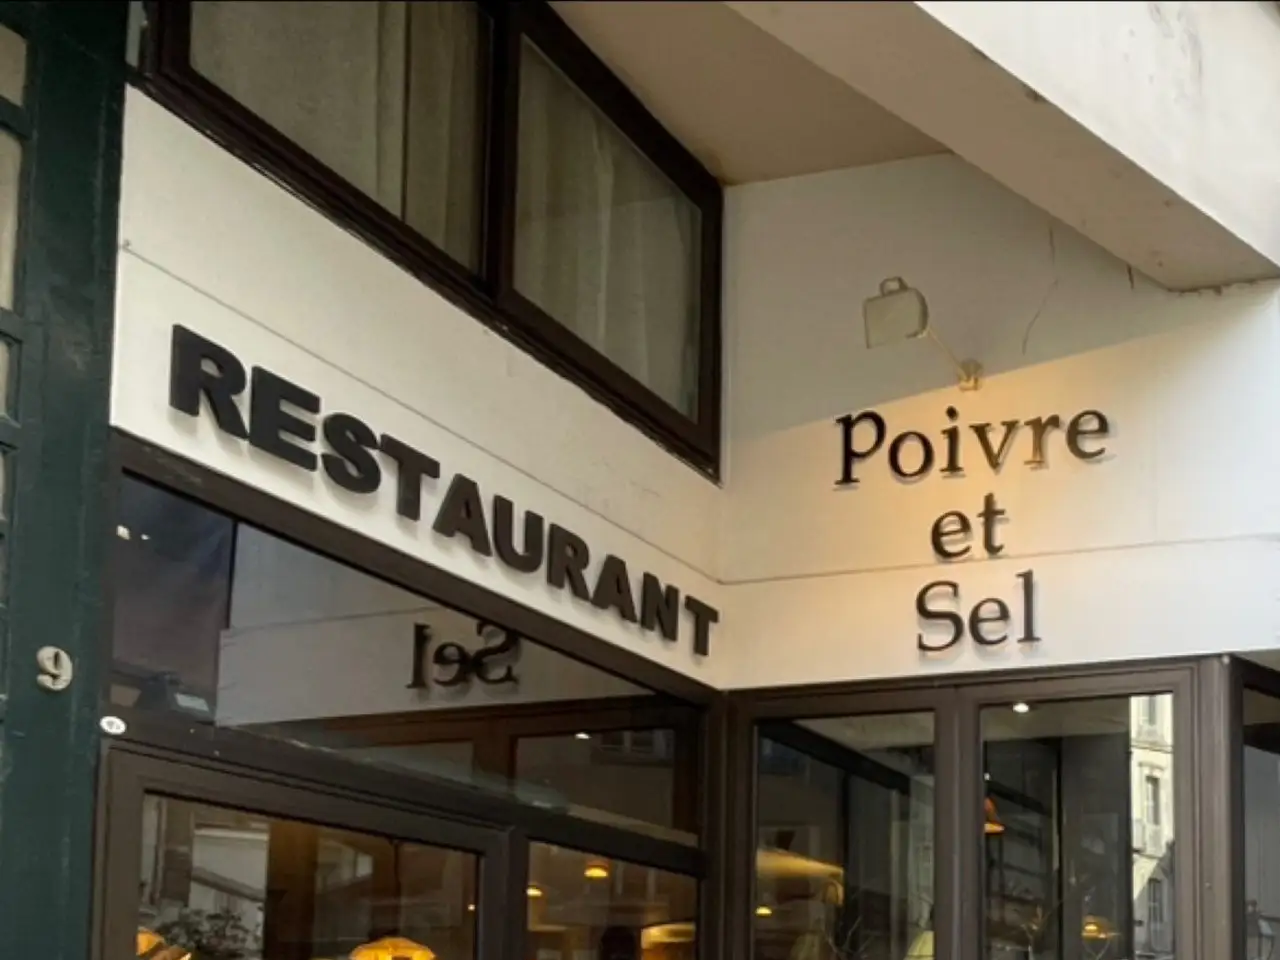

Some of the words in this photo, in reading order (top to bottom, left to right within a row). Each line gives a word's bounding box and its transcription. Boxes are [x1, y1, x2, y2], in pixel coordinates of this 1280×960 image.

[834, 405, 1110, 486] Poivre
[168, 322, 720, 658] RESTAURANT
[930, 492, 1007, 560] et
[915, 569, 1043, 654] Sel
[36, 645, 74, 691] 9
